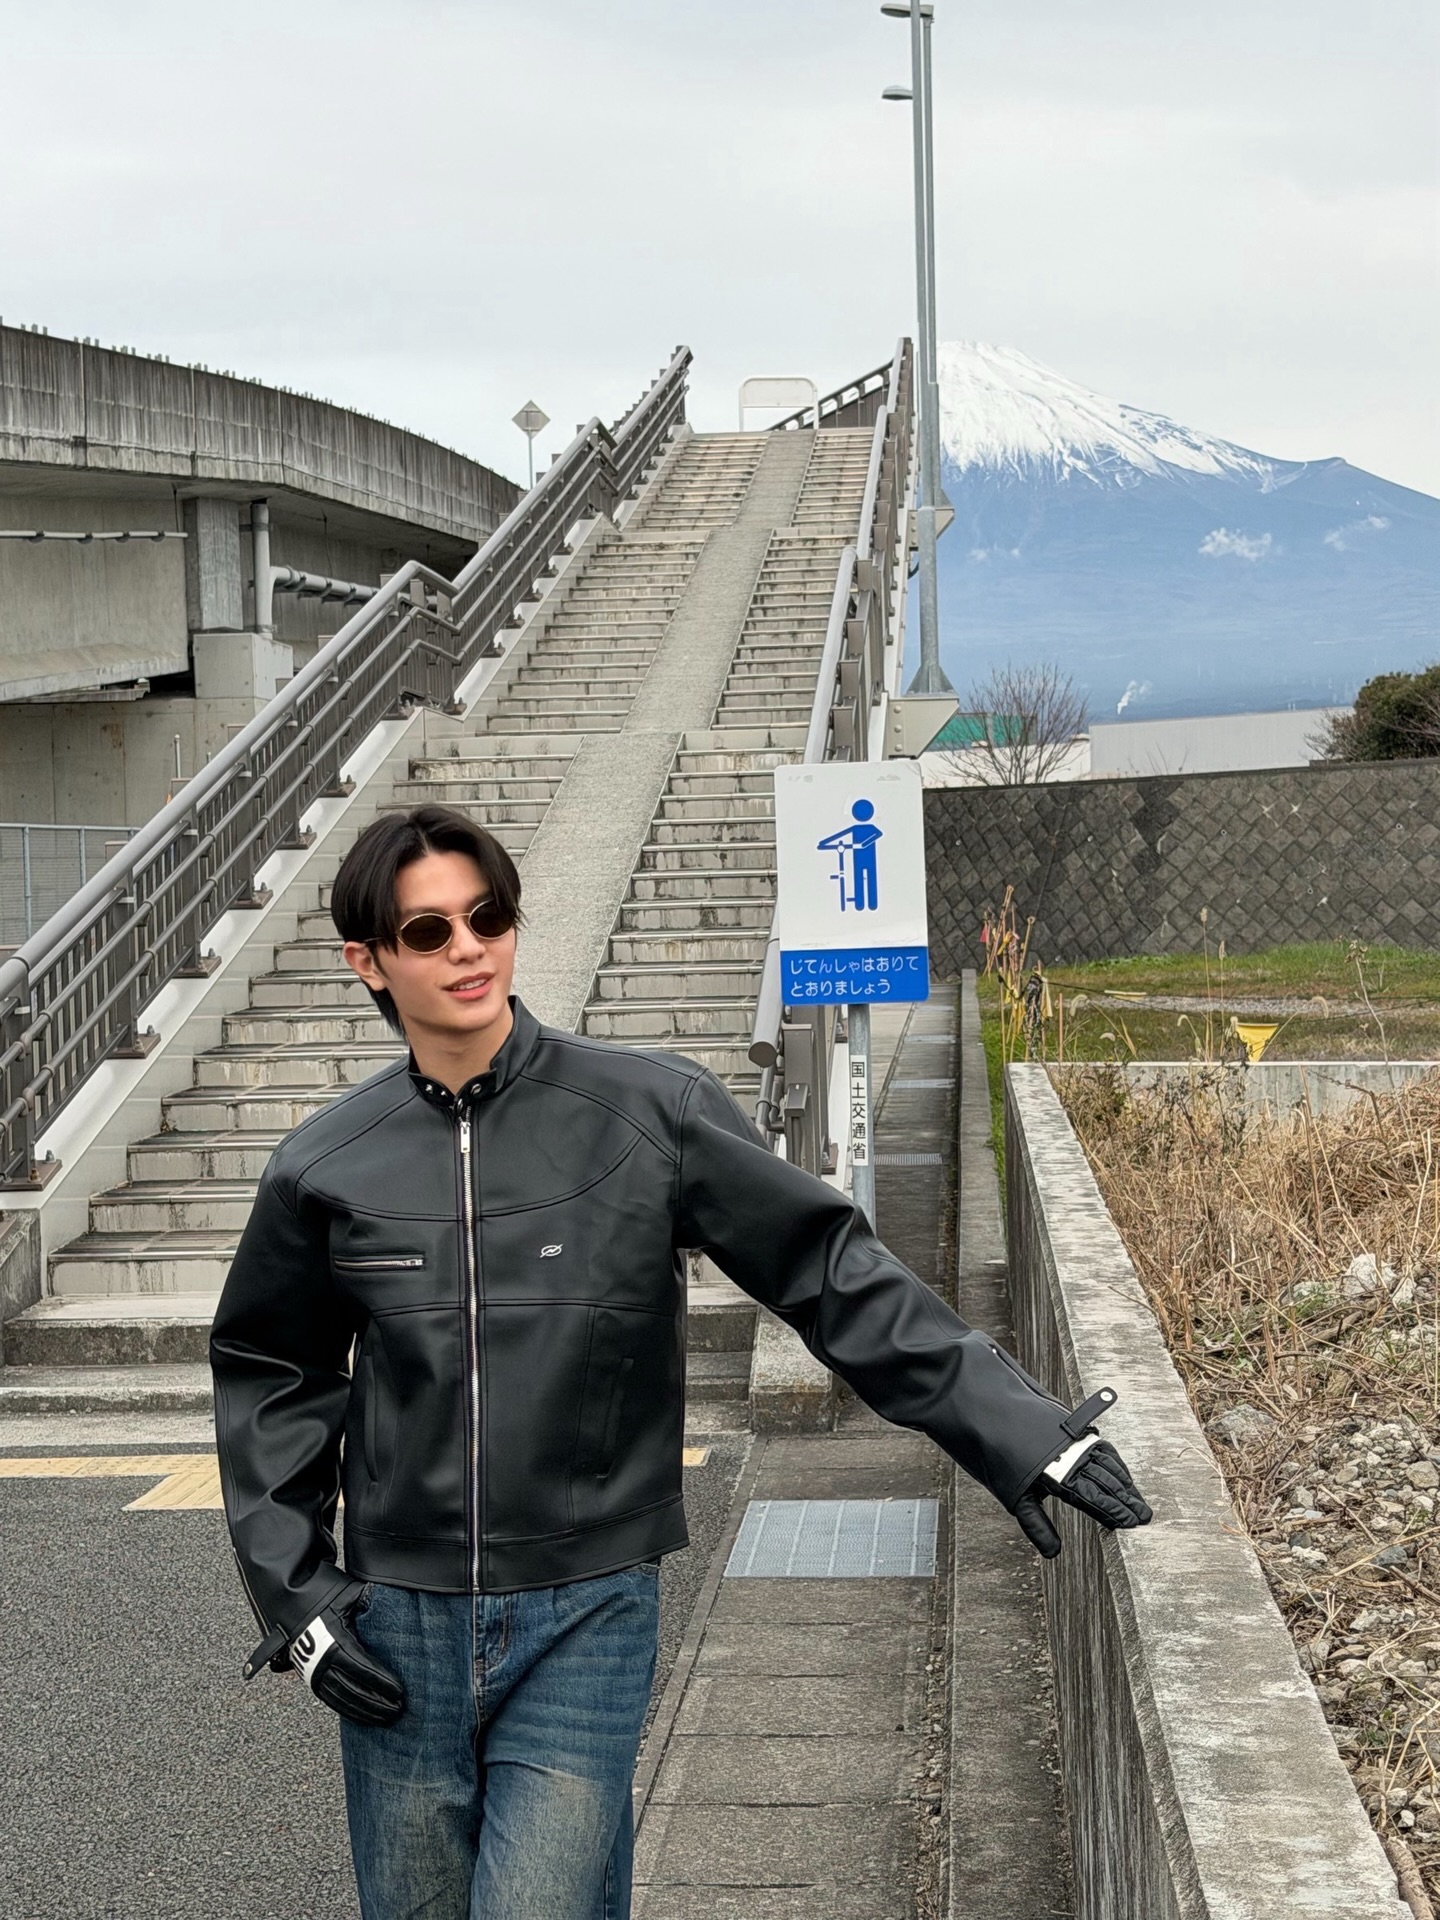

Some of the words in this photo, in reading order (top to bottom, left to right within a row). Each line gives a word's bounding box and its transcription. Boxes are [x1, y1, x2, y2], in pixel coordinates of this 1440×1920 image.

[790, 955, 919, 975] じてんしゃはおりて
[790, 978, 891, 998] とおりましょう
[851, 1061, 867, 1160] 国土交通省
